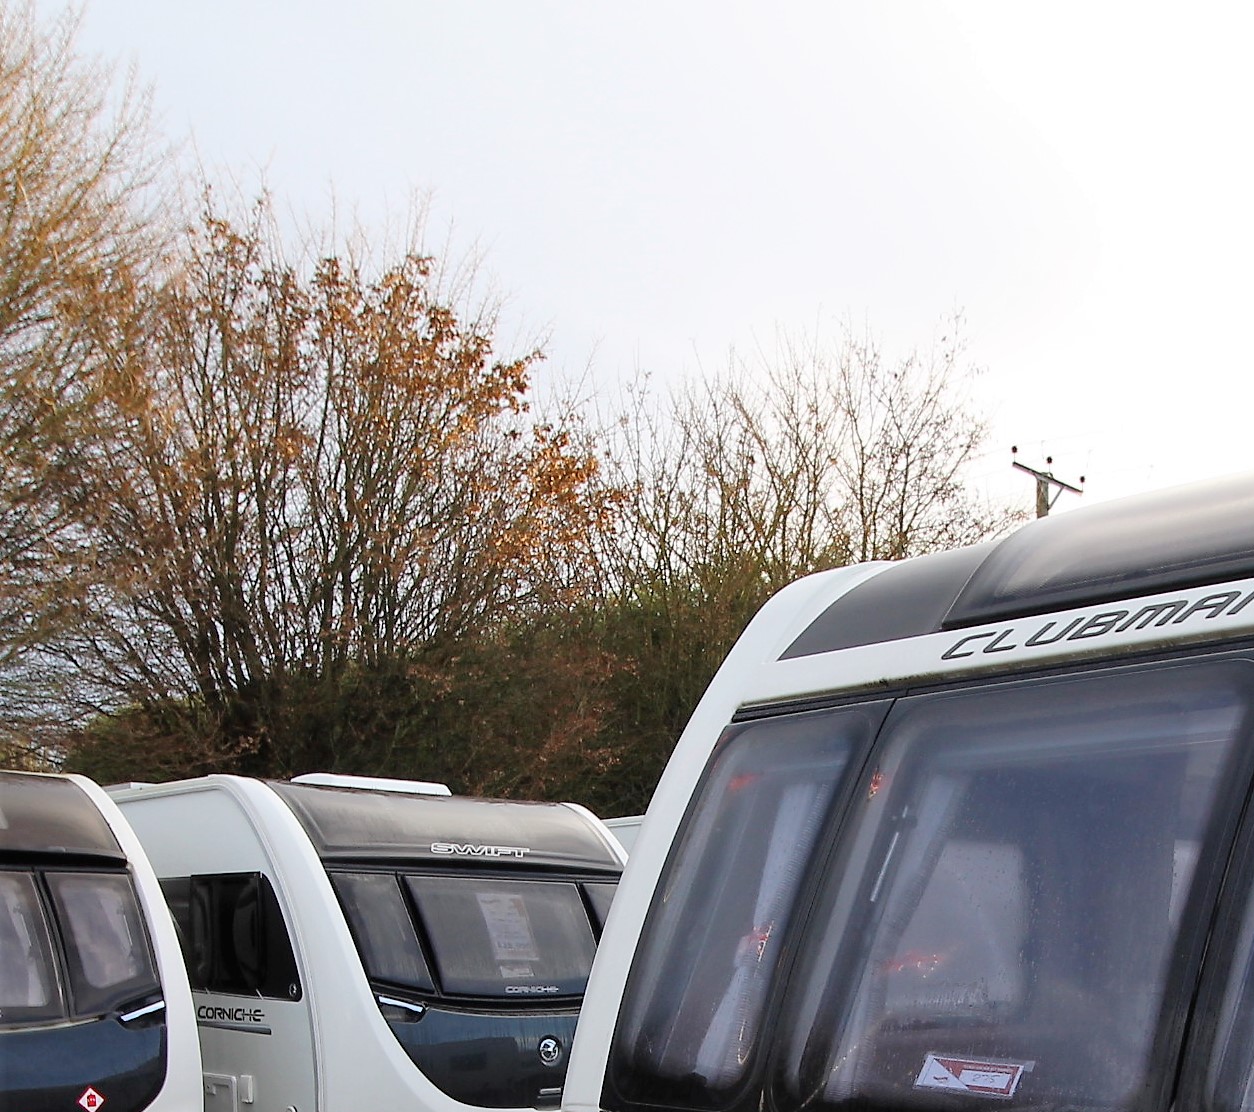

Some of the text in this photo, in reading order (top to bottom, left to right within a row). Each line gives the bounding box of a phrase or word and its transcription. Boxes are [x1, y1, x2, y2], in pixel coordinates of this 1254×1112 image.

[430, 842, 530, 858] SWIFT
[504, 985, 559, 994] CORNICHE
[197, 1005, 265, 1022] CORNICHE
